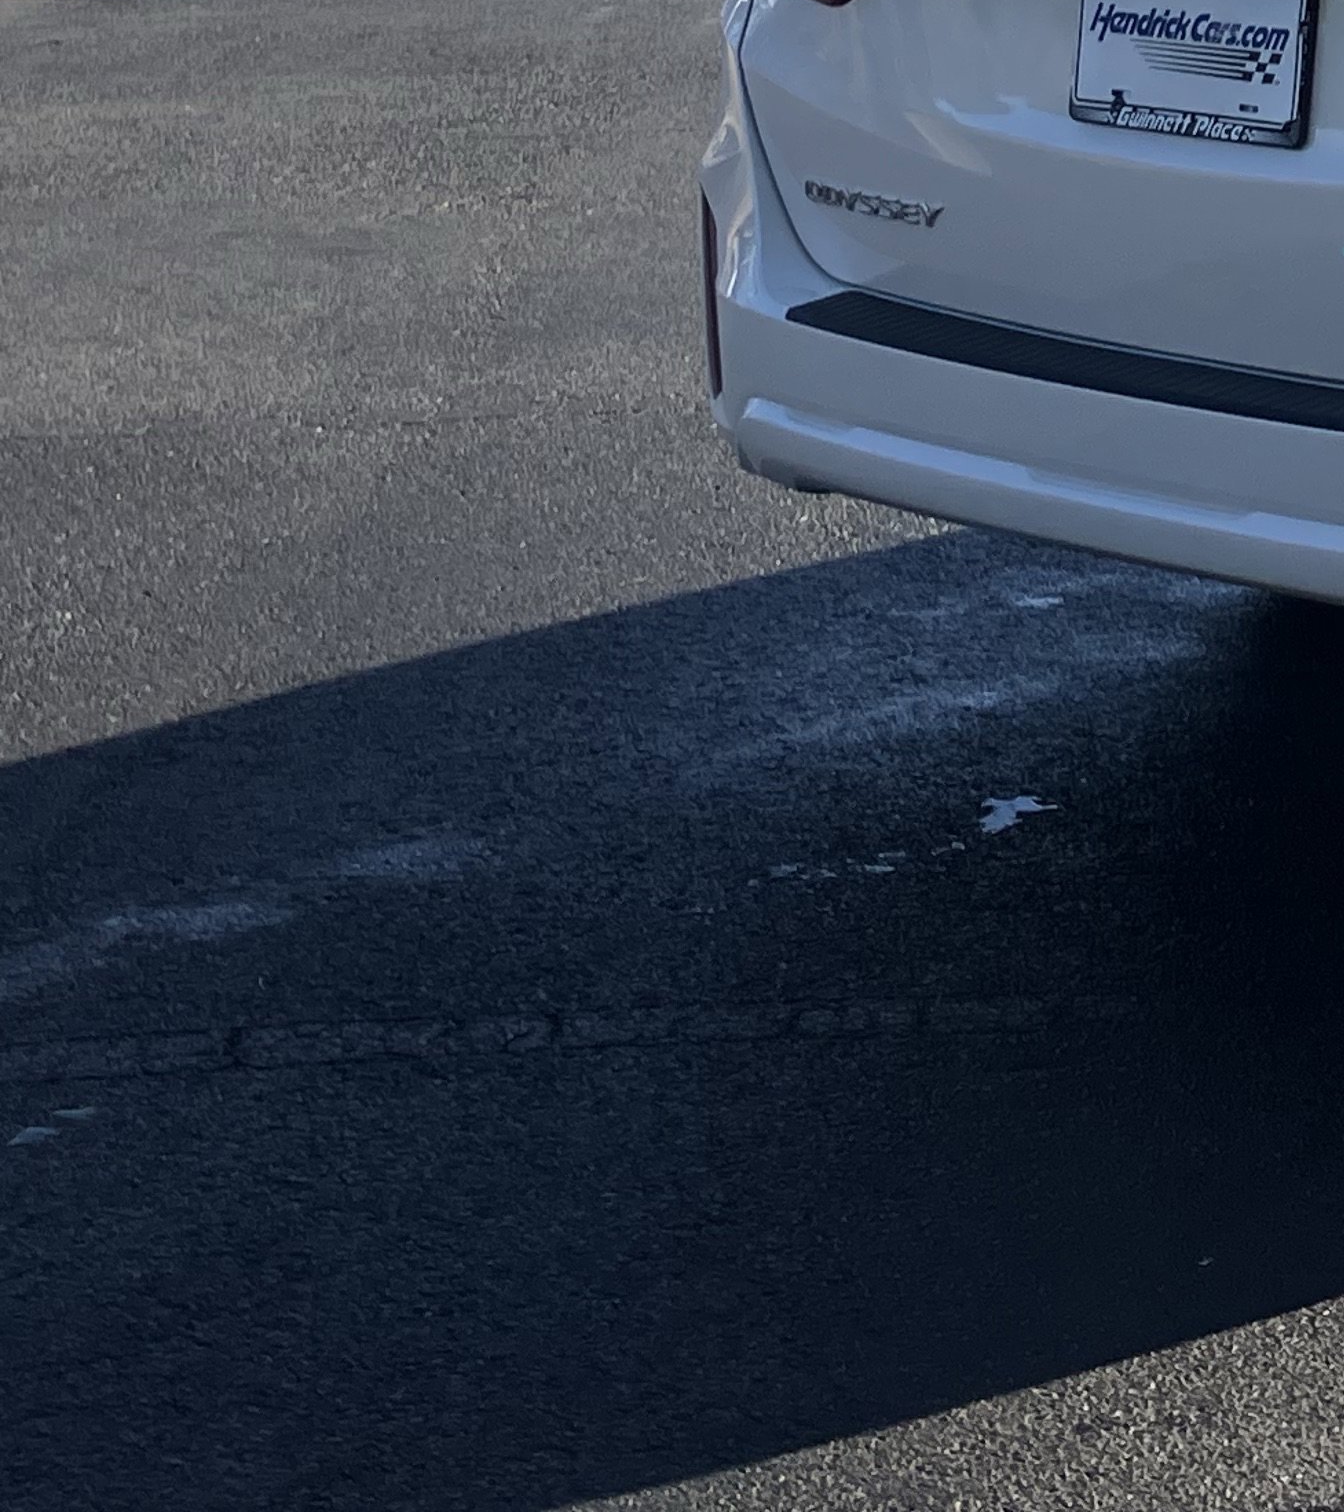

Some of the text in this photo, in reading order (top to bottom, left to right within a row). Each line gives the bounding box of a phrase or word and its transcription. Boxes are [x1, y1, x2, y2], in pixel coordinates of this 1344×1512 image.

[1116, 105, 1245, 141] Gwinnett Place
[805, 180, 945, 228] ODYSSEY
